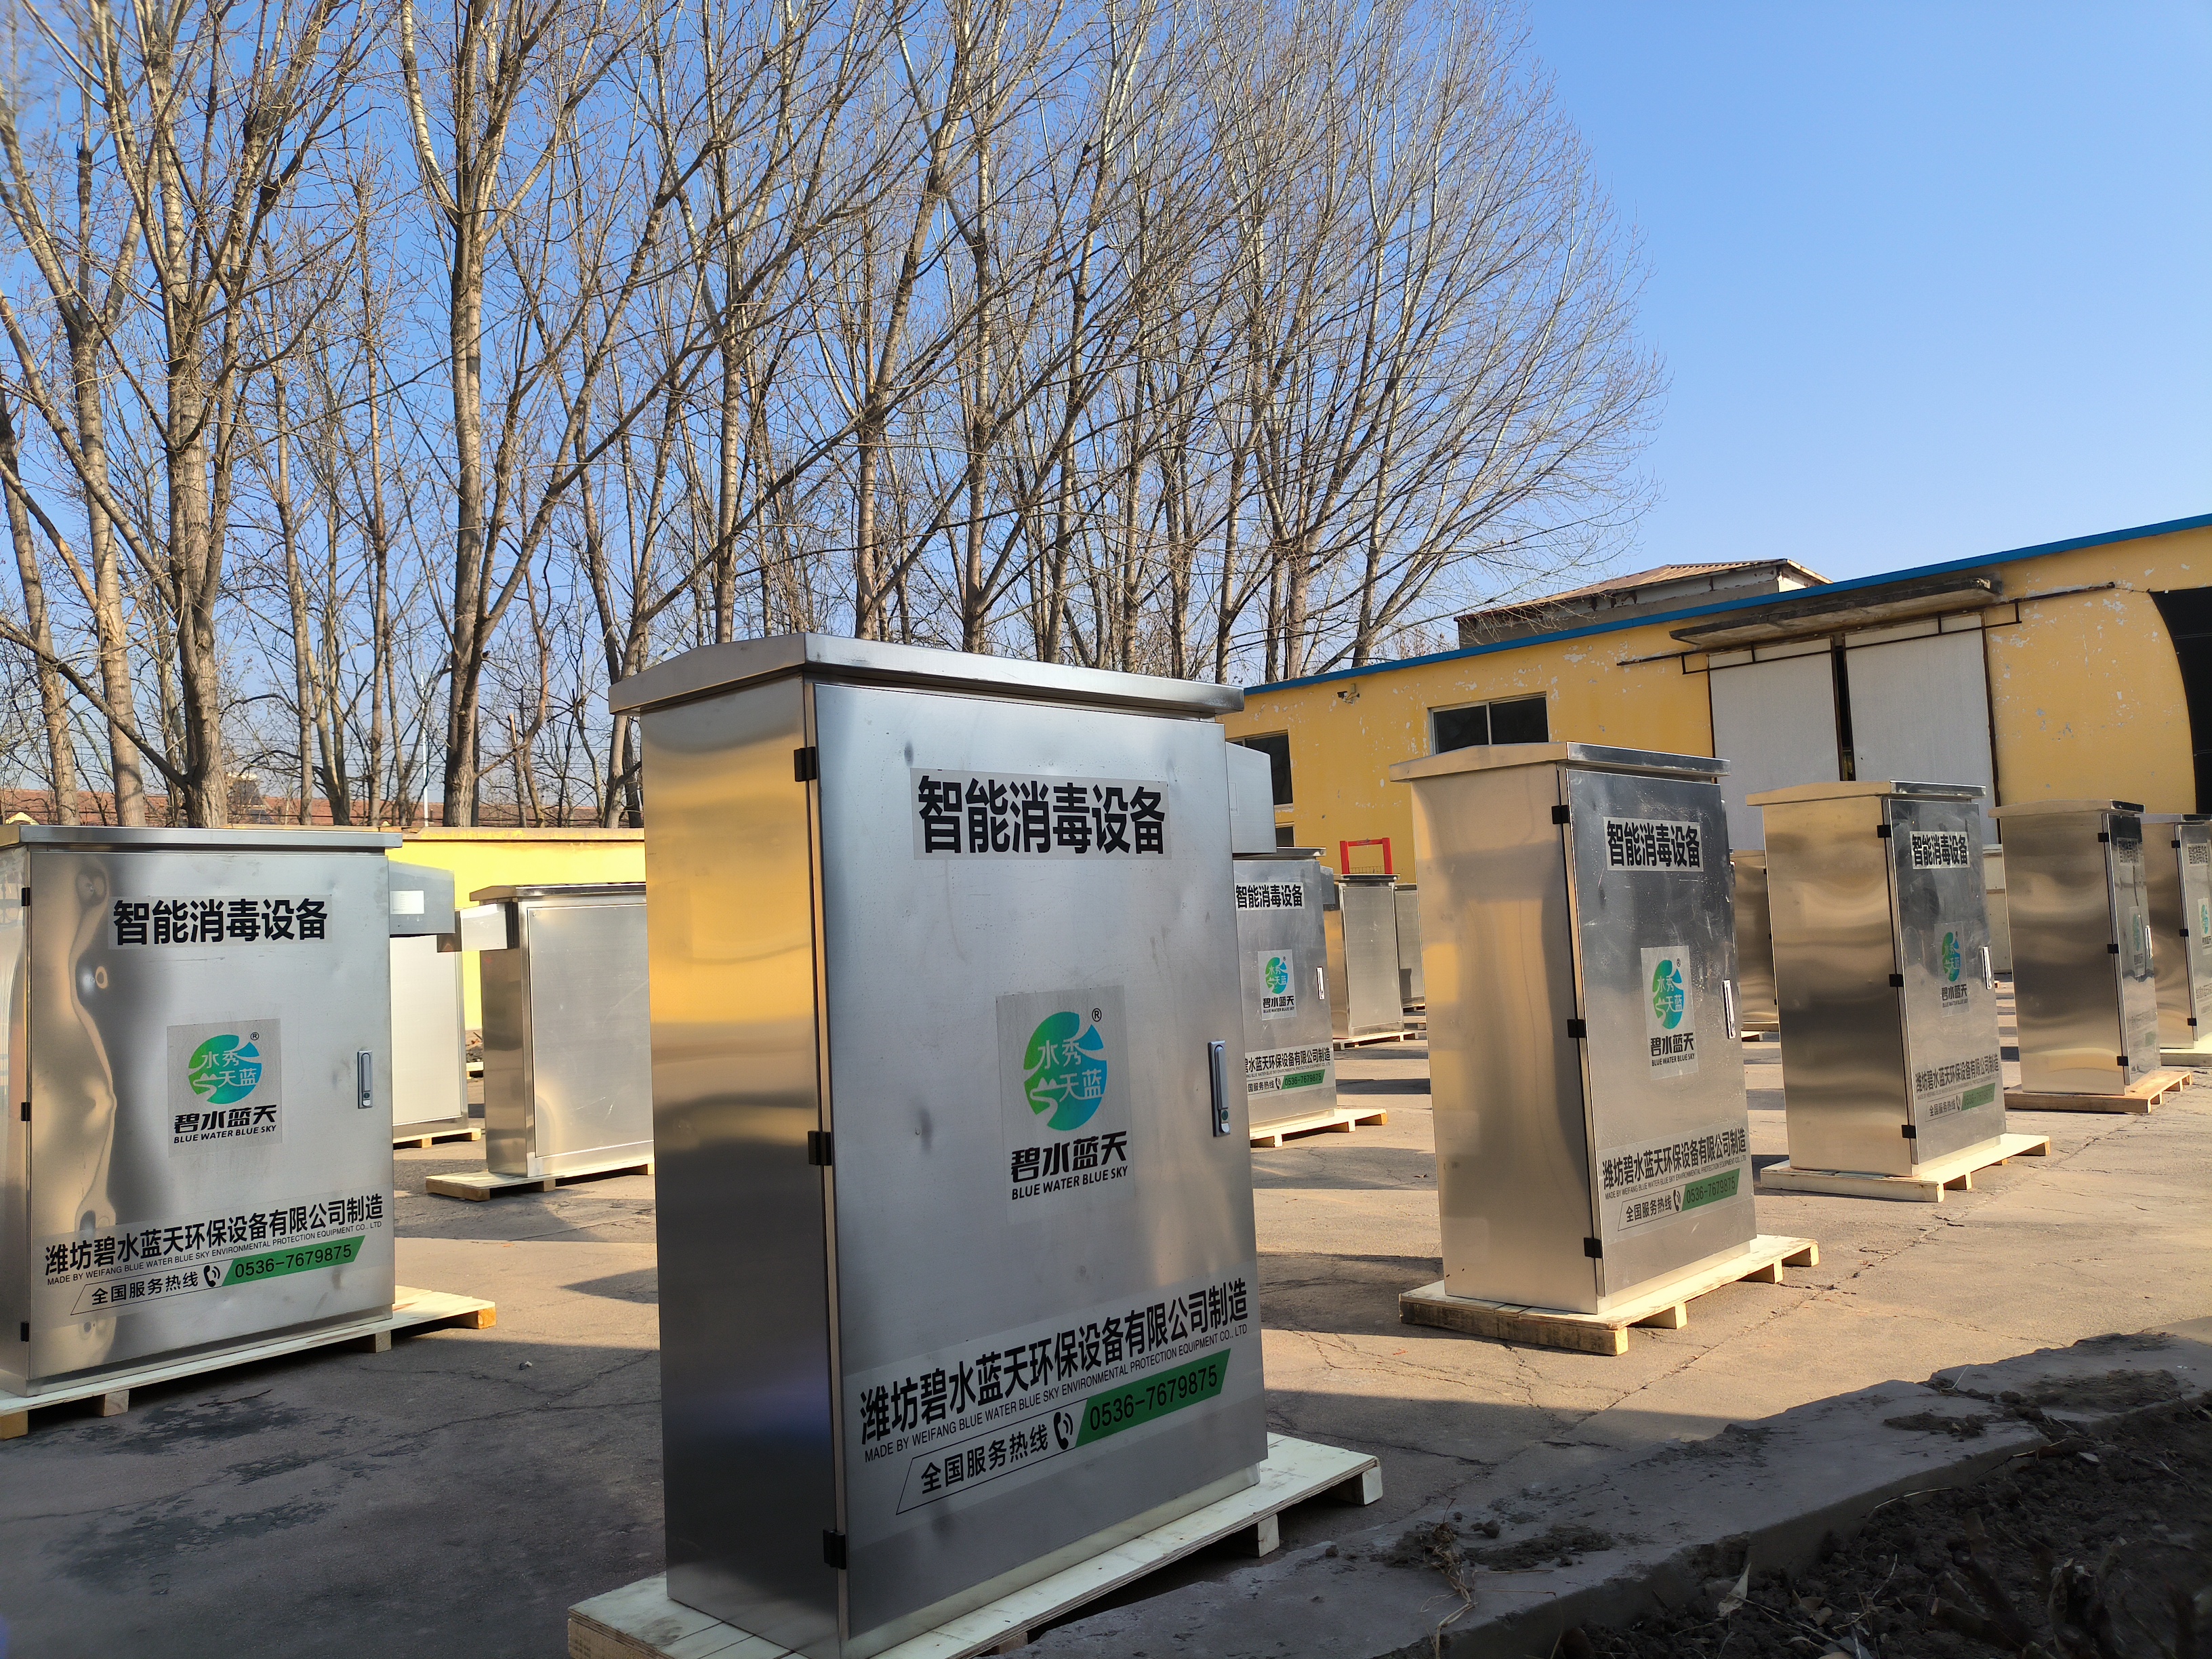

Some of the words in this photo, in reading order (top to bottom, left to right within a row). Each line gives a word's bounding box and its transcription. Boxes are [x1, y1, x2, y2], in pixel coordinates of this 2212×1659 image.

[918, 775, 1165, 855] 智能消毒设备
[1607, 821, 1700, 867] 智能消毒设备
[1912, 834, 1967, 866] 智能消毒设备
[1235, 884, 1303, 908] 智能消毒设备
[113, 899, 328, 945] 智能消毒设备
[1658, 976, 1675, 992] 水秀
[1941, 984, 1967, 1001] 碧水蓝天
[1263, 996, 1294, 1008] 碧水蓝天
[201, 1050, 239, 1069] 水秀
[1038, 1039, 1082, 1069] 水秀
[1650, 1032, 1694, 1057] 碧水蓝天
[1652, 1058, 1662, 1067] BLUE
[1662, 1056, 1677, 1065] WATER
[1677, 1054, 1687, 1062] BLUE
[218, 1068, 258, 1088] 天蓝
[1059, 1068, 1103, 1102] 天蓝
[1284, 1073, 1322, 1086] 0536-7679875
[173, 1134, 199, 1143] BLUE
[201, 1130, 233, 1140] WATER
[235, 1126, 259, 1136] BLUE
[174, 1105, 277, 1133] 碧水蓝天
[1011, 1130, 1127, 1183] 碧水蓝天
[1602, 1126, 1746, 1190] 潍坊碧水蓝天环保设备有限公司制造
[1012, 1184, 1040, 1200] BLUE
[1042, 1175, 1080, 1193] WATER
[1082, 1169, 1109, 1185] BLUE
[1111, 1165, 1128, 1180] SKY
[1605, 1191, 1616, 1200] MADE
[1622, 1185, 1638, 1195] WEIFANG
[1638, 1183, 1647, 1191] BLUE
[1647, 1179, 1660, 1188] WATER
[1660, 1176, 1668, 1185] BLUE
[1626, 1195, 1672, 1223] 全国服务热线
[1686, 1176, 1736, 1204] 0536-7679875
[45, 1193, 383, 1275] 潍坊碧水蓝天环保设备有限公司制造
[47, 1275, 70, 1286] MADE
[73, 1273, 83, 1281] BY
[86, 1266, 122, 1278] WEIFANG
[124, 1263, 144, 1272] BLUE
[146, 1258, 173, 1268] WATER
[174, 1254, 194, 1264] BLUE
[195, 1251, 209, 1260] SKY
[212, 1241, 270, 1256] ENVIRONMENTAL
[272, 1233, 315, 1246] PROTECTION
[317, 1226, 354, 1238] EQUIPMENT
[370, 1221, 382, 1229] LTD
[91, 1271, 199, 1305] 全国服务热线
[235, 1244, 352, 1277] 0536-7679875
[860, 1277, 1248, 1445] 潍坊碧水蓝天环保设备有限公司制造
[865, 1443, 893, 1462] MADE
[897, 1437, 909, 1452] BY
[912, 1422, 956, 1446] WEIFANG
[959, 1414, 983, 1431] BLUE
[985, 1401, 1017, 1421] WATER
[1019, 1393, 1041, 1410] BLUE
[1043, 1386, 1059, 1401] SKY
[1062, 1366, 1128, 1395] ENVIRONMENTAL
[1130, 1349, 1177, 1372] PROTECTION
[1179, 1333, 1218, 1355] EQUIPMENT
[1235, 1324, 1247, 1336] LTD
[920, 1423, 1048, 1494] 全国服务热线
[1090, 1364, 1218, 1431] 0536-7679875
